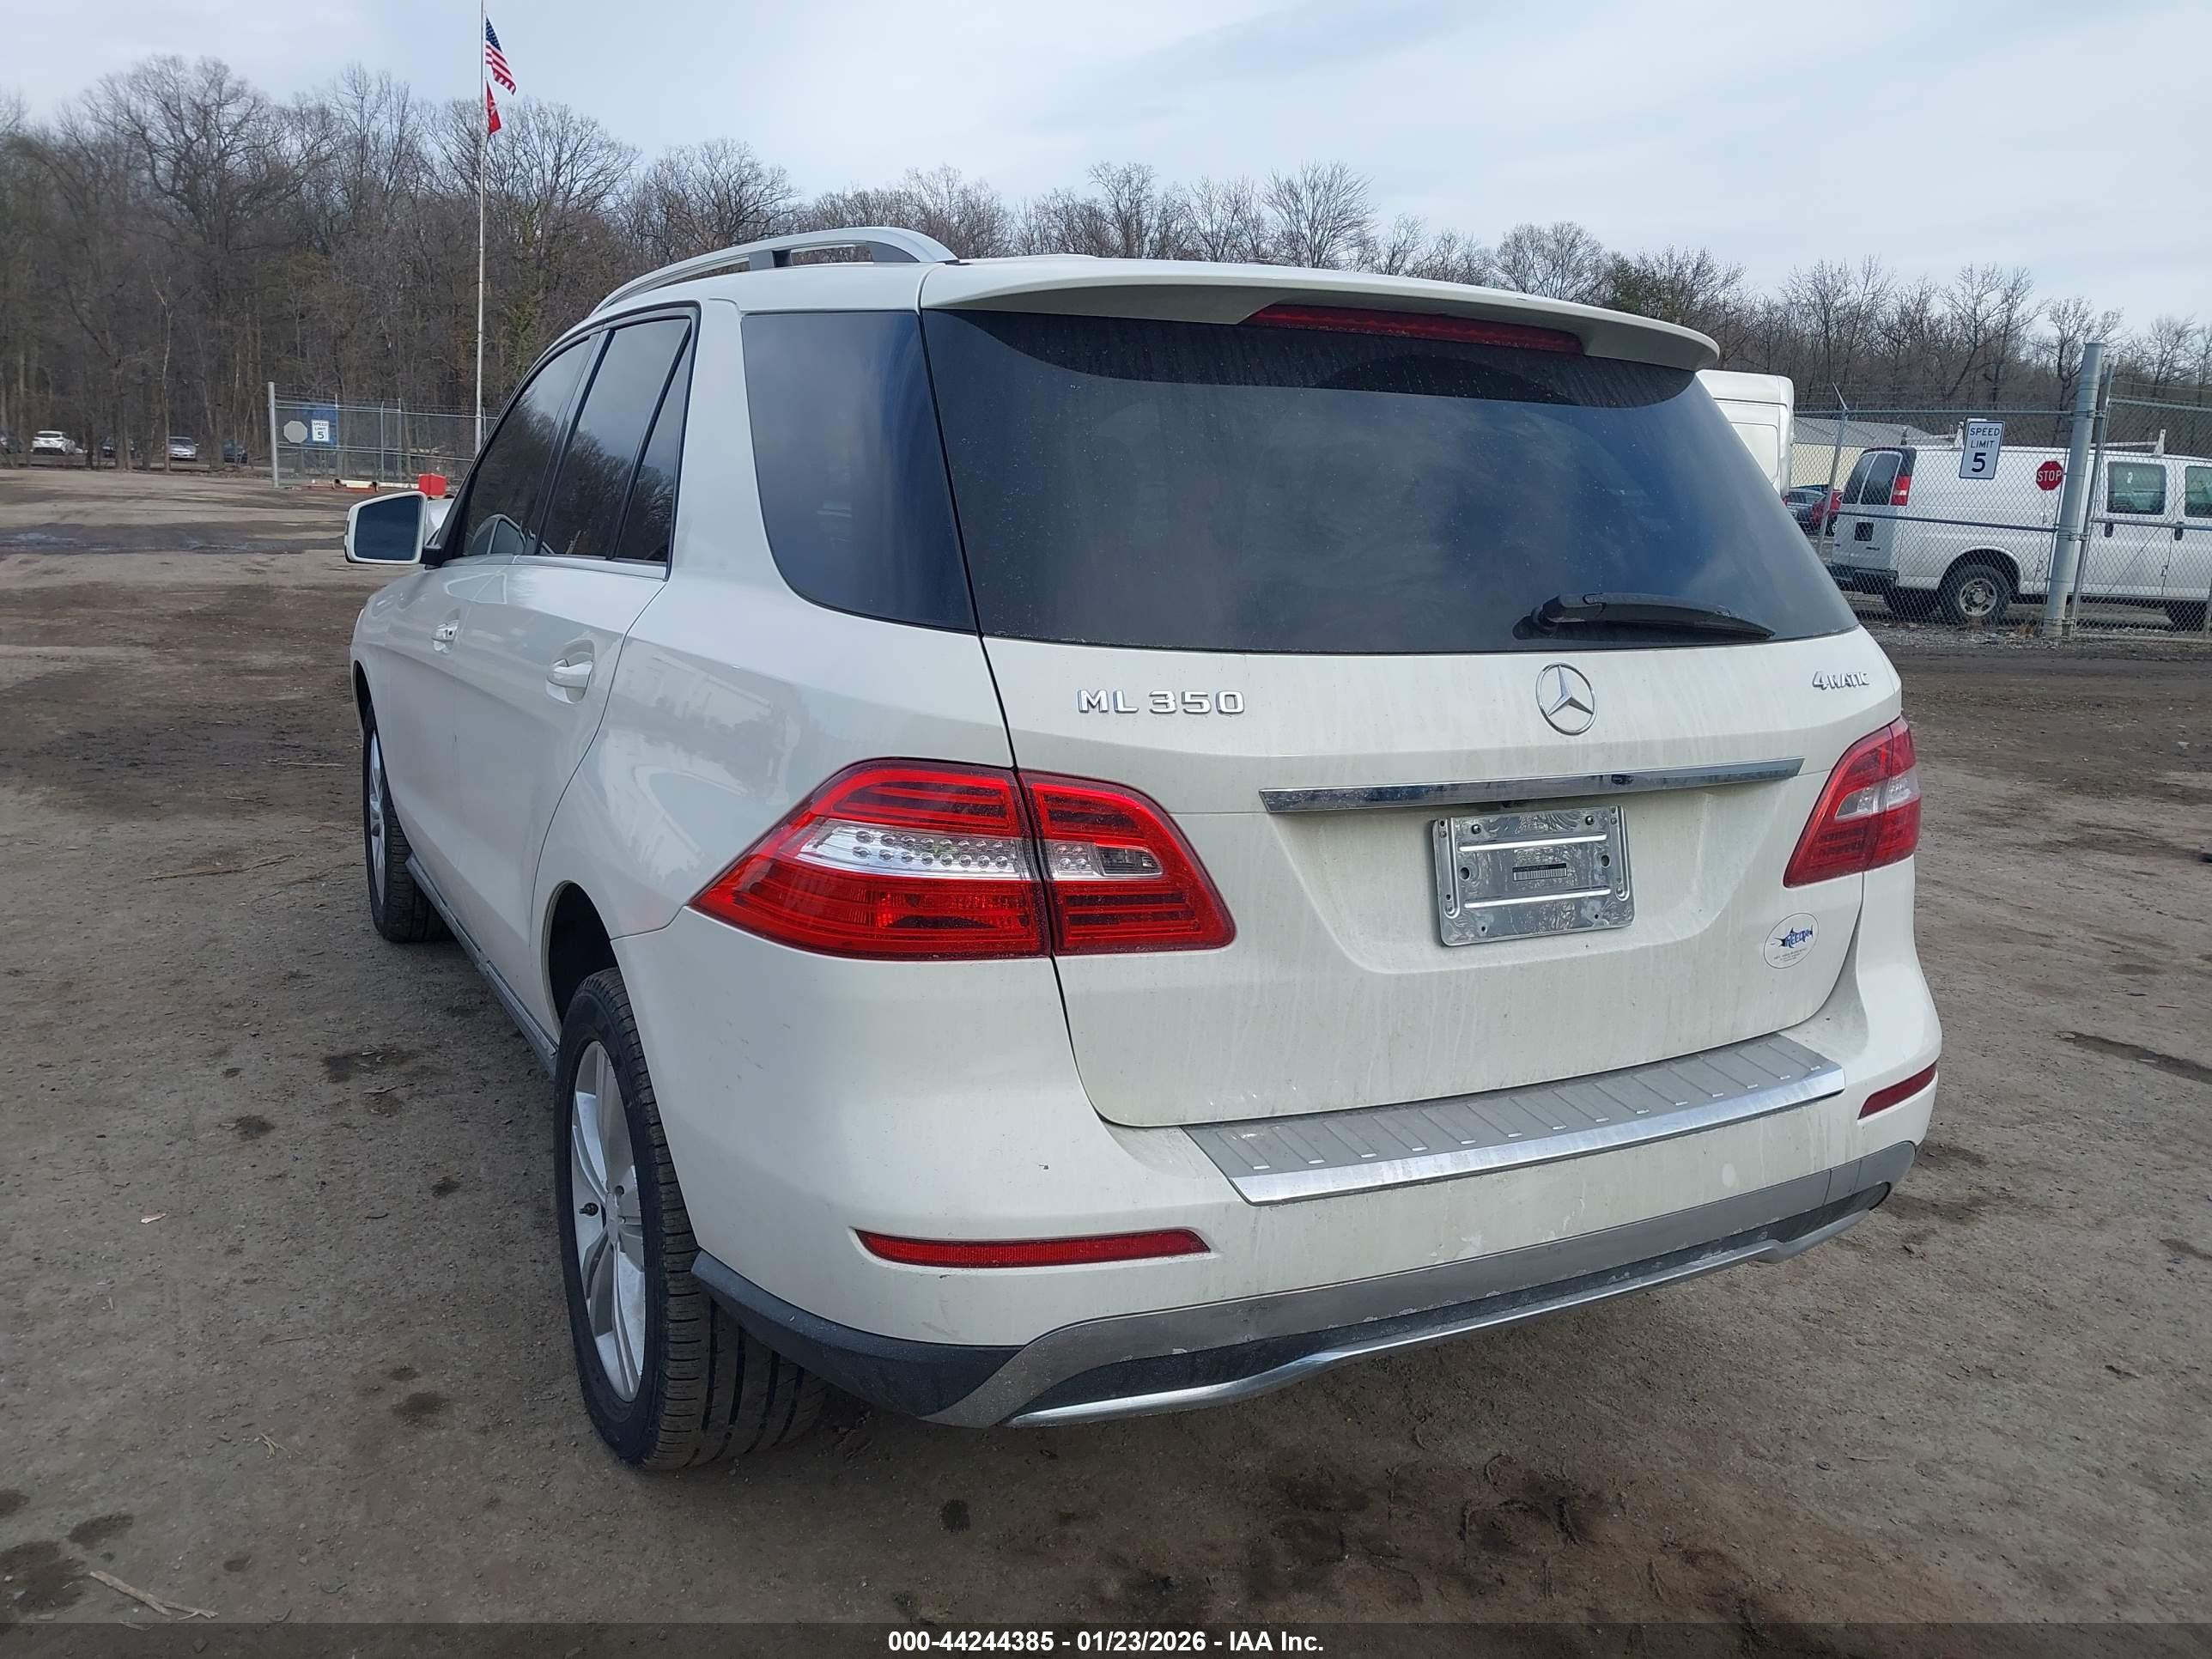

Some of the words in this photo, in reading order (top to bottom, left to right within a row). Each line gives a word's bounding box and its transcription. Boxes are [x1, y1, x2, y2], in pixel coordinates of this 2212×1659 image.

[317, 431, 325, 440] 5
[1970, 428, 2000, 436] SPEED
[1971, 440, 1995, 448] LIMIT
[1972, 452, 1986, 473] 5
[2037, 470, 2063, 483] STOP
[1812, 672, 1869, 690] 4MATIC
[1077, 690, 1139, 714] ML
[1149, 690, 1245, 715] 350
